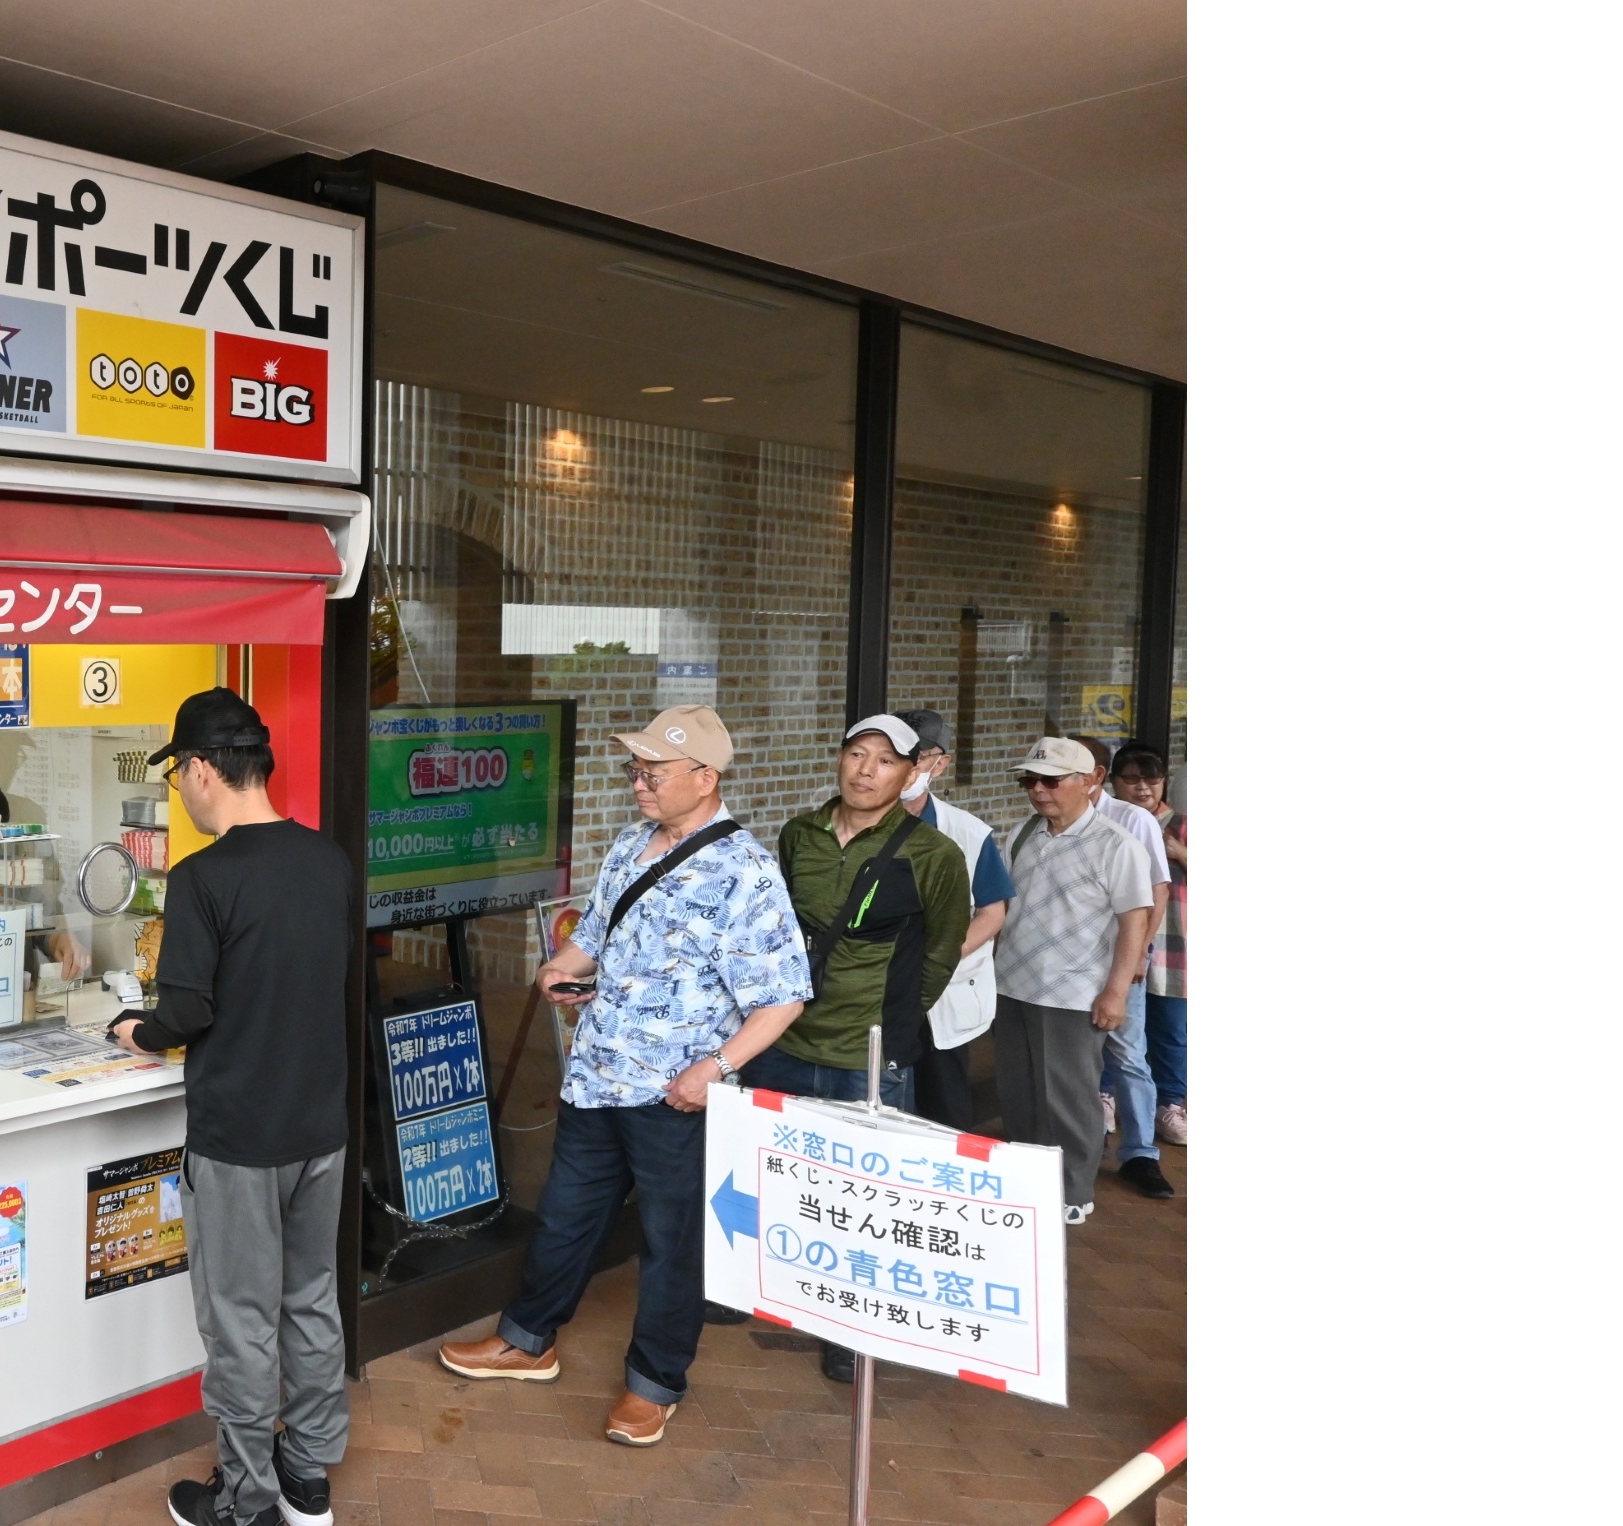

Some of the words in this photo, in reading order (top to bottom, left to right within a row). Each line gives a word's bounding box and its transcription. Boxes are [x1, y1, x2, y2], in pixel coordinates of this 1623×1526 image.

[89, 353, 195, 401] toto
[230, 375, 314, 425] BIG
[369, 887, 437, 909] じの収益金は
[387, 1018, 418, 1038] 令和7年
[421, 1005, 473, 1030] ドリームジャンボ
[400, 1123, 427, 1144] 令和7年
[429, 1108, 485, 1135] ドリームジャンボミニ
[766, 1154, 1025, 1231] 紙くじ・スクラッチくじの
[798, 1192, 987, 1262] 当せん確認は
[795, 1278, 990, 1343] でお受け致します
